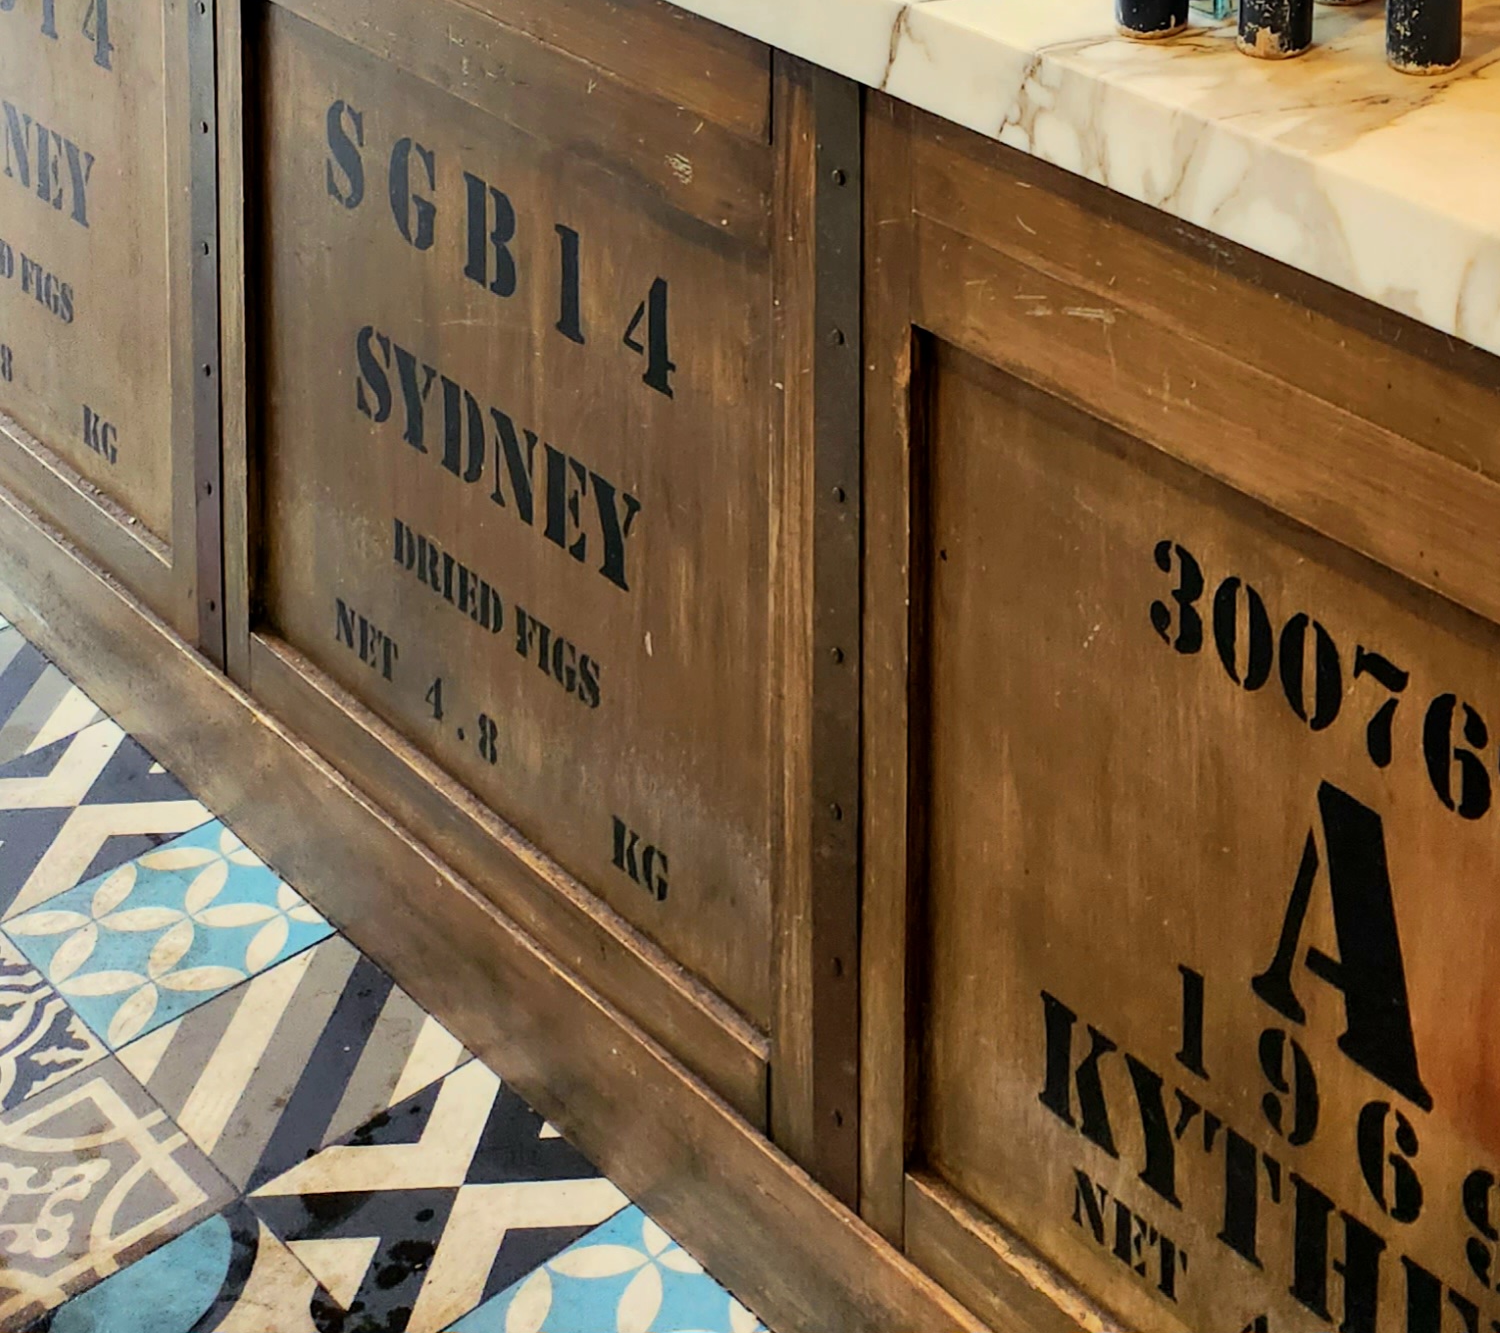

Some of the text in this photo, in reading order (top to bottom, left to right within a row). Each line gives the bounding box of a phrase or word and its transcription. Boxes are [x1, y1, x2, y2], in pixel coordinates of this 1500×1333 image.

[21, 250, 74, 325] FIGS
[82, 402, 118, 467] KG
[354, 324, 643, 592] SYDNEY
[392, 517, 602, 710] DRIED FIGS
[334, 596, 402, 685] NET
[609, 814, 670, 904] KG
[1250, 777, 1435, 1114] A
[1071, 1167, 1189, 1304] NET
